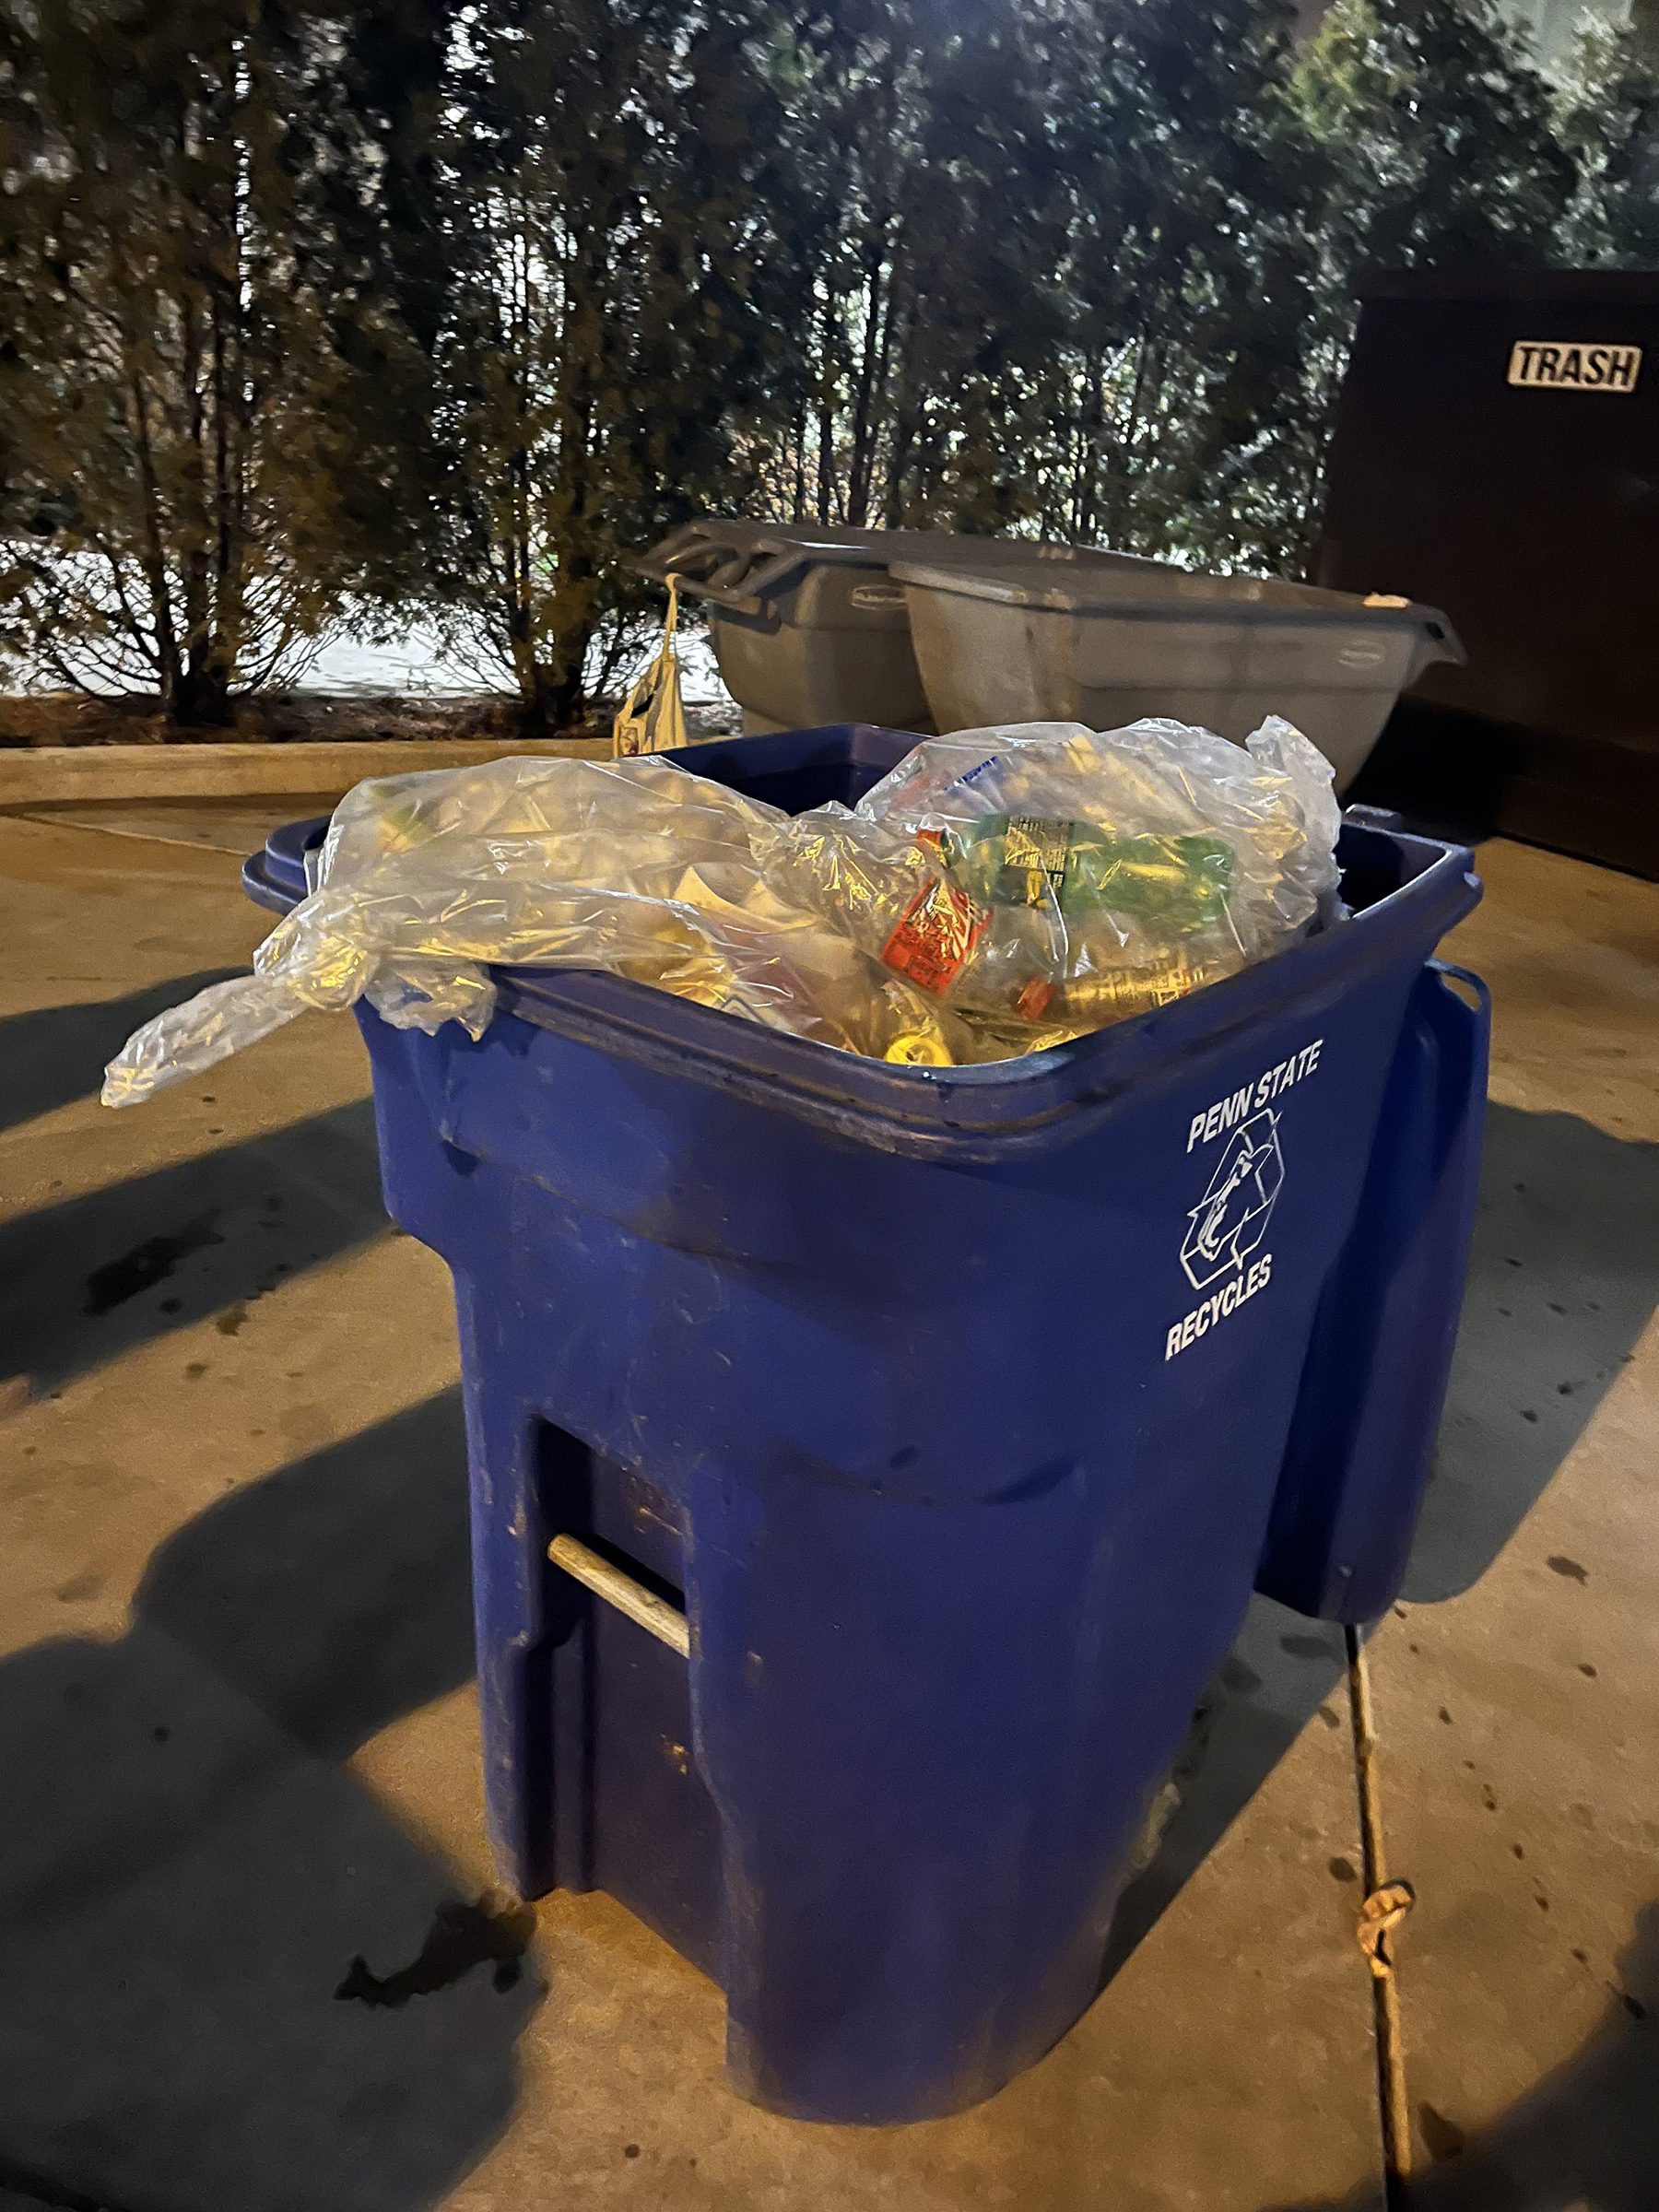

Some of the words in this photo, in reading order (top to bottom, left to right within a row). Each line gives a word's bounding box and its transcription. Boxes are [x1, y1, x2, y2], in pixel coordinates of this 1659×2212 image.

[1519, 346, 1634, 386] TRASH
[1186, 1082, 1254, 1153] PENN
[1253, 1039, 1324, 1108] STATE
[1165, 1253, 1272, 1361] RECYCLES
